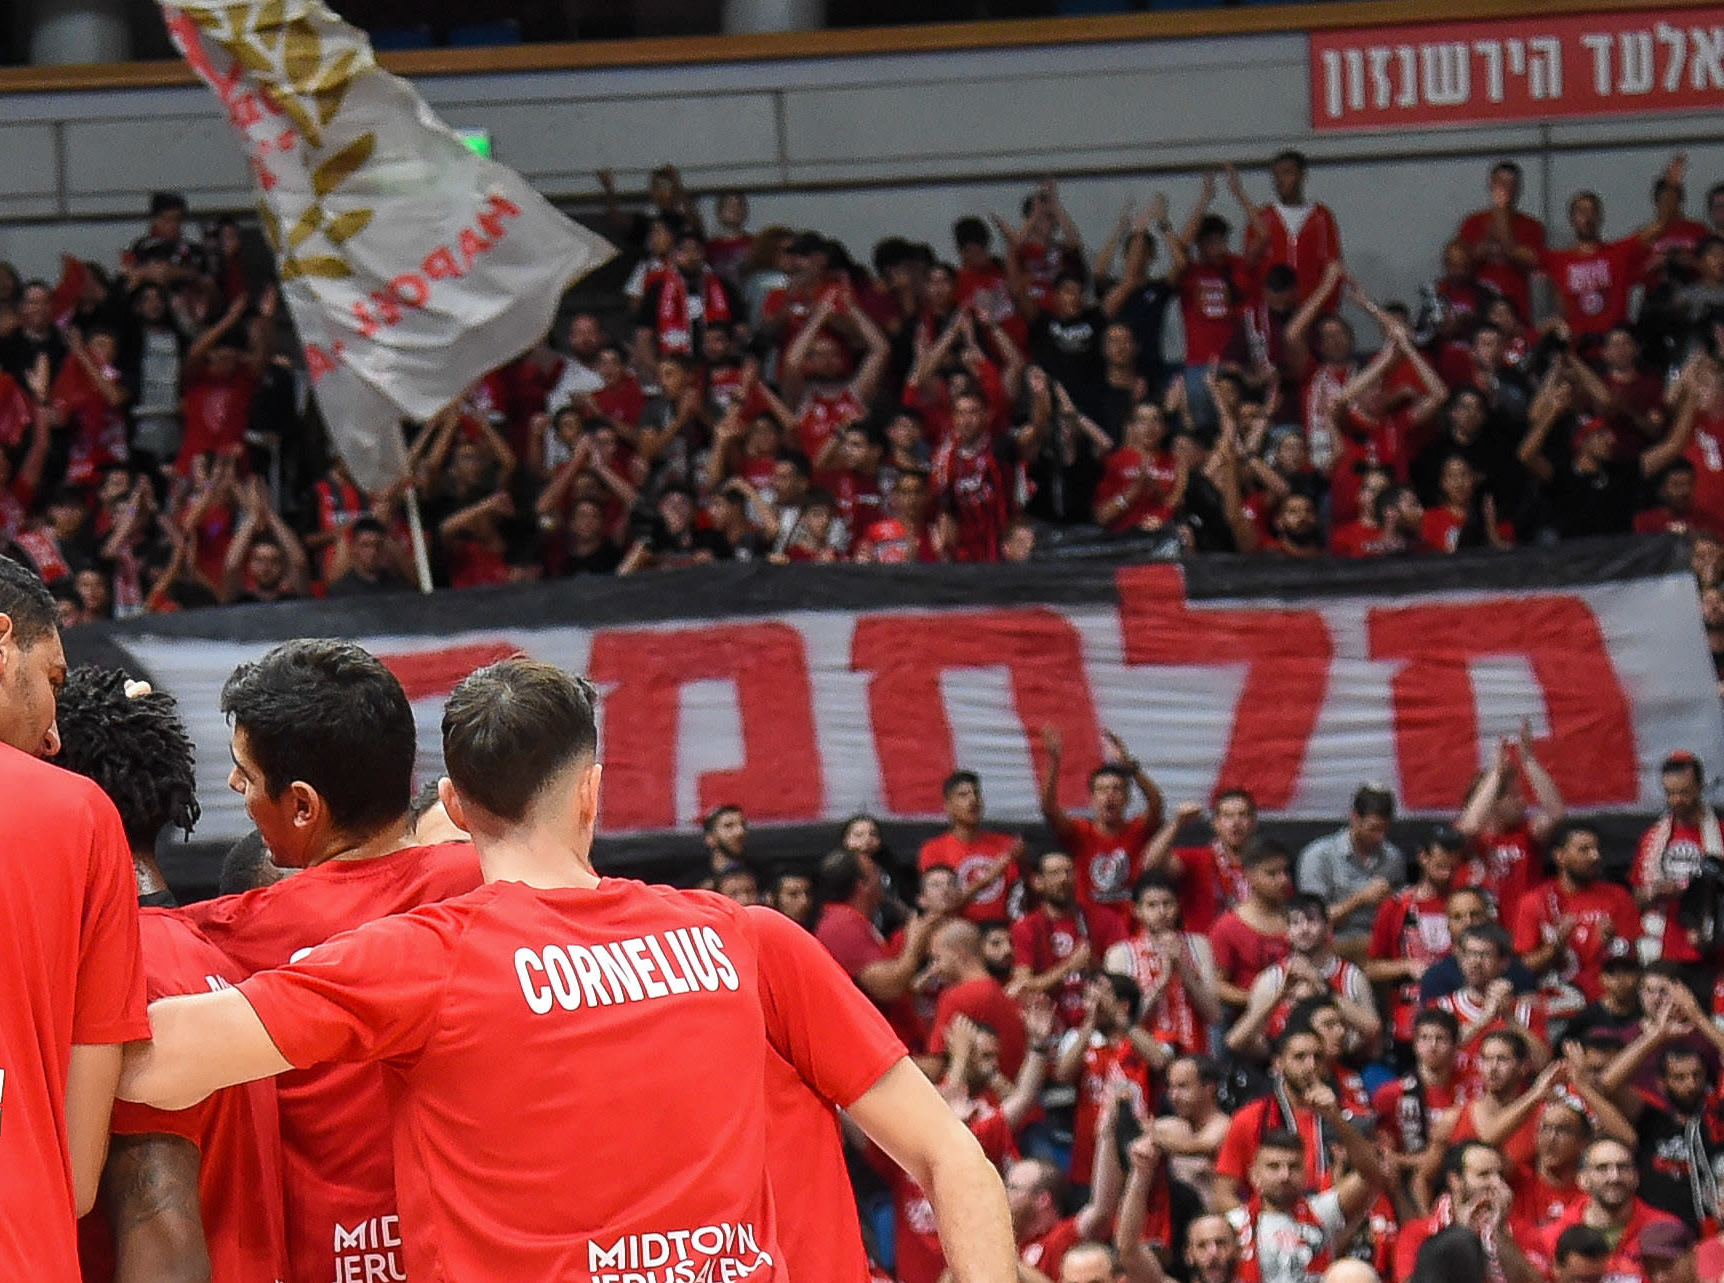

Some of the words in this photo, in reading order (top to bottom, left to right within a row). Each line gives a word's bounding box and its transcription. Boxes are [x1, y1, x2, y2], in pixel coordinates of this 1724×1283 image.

[1322, 36, 1564, 119] הירשנזון
[1580, 22, 1724, 97] אלעד
[513, 925, 740, 1015] CORNELIUS
